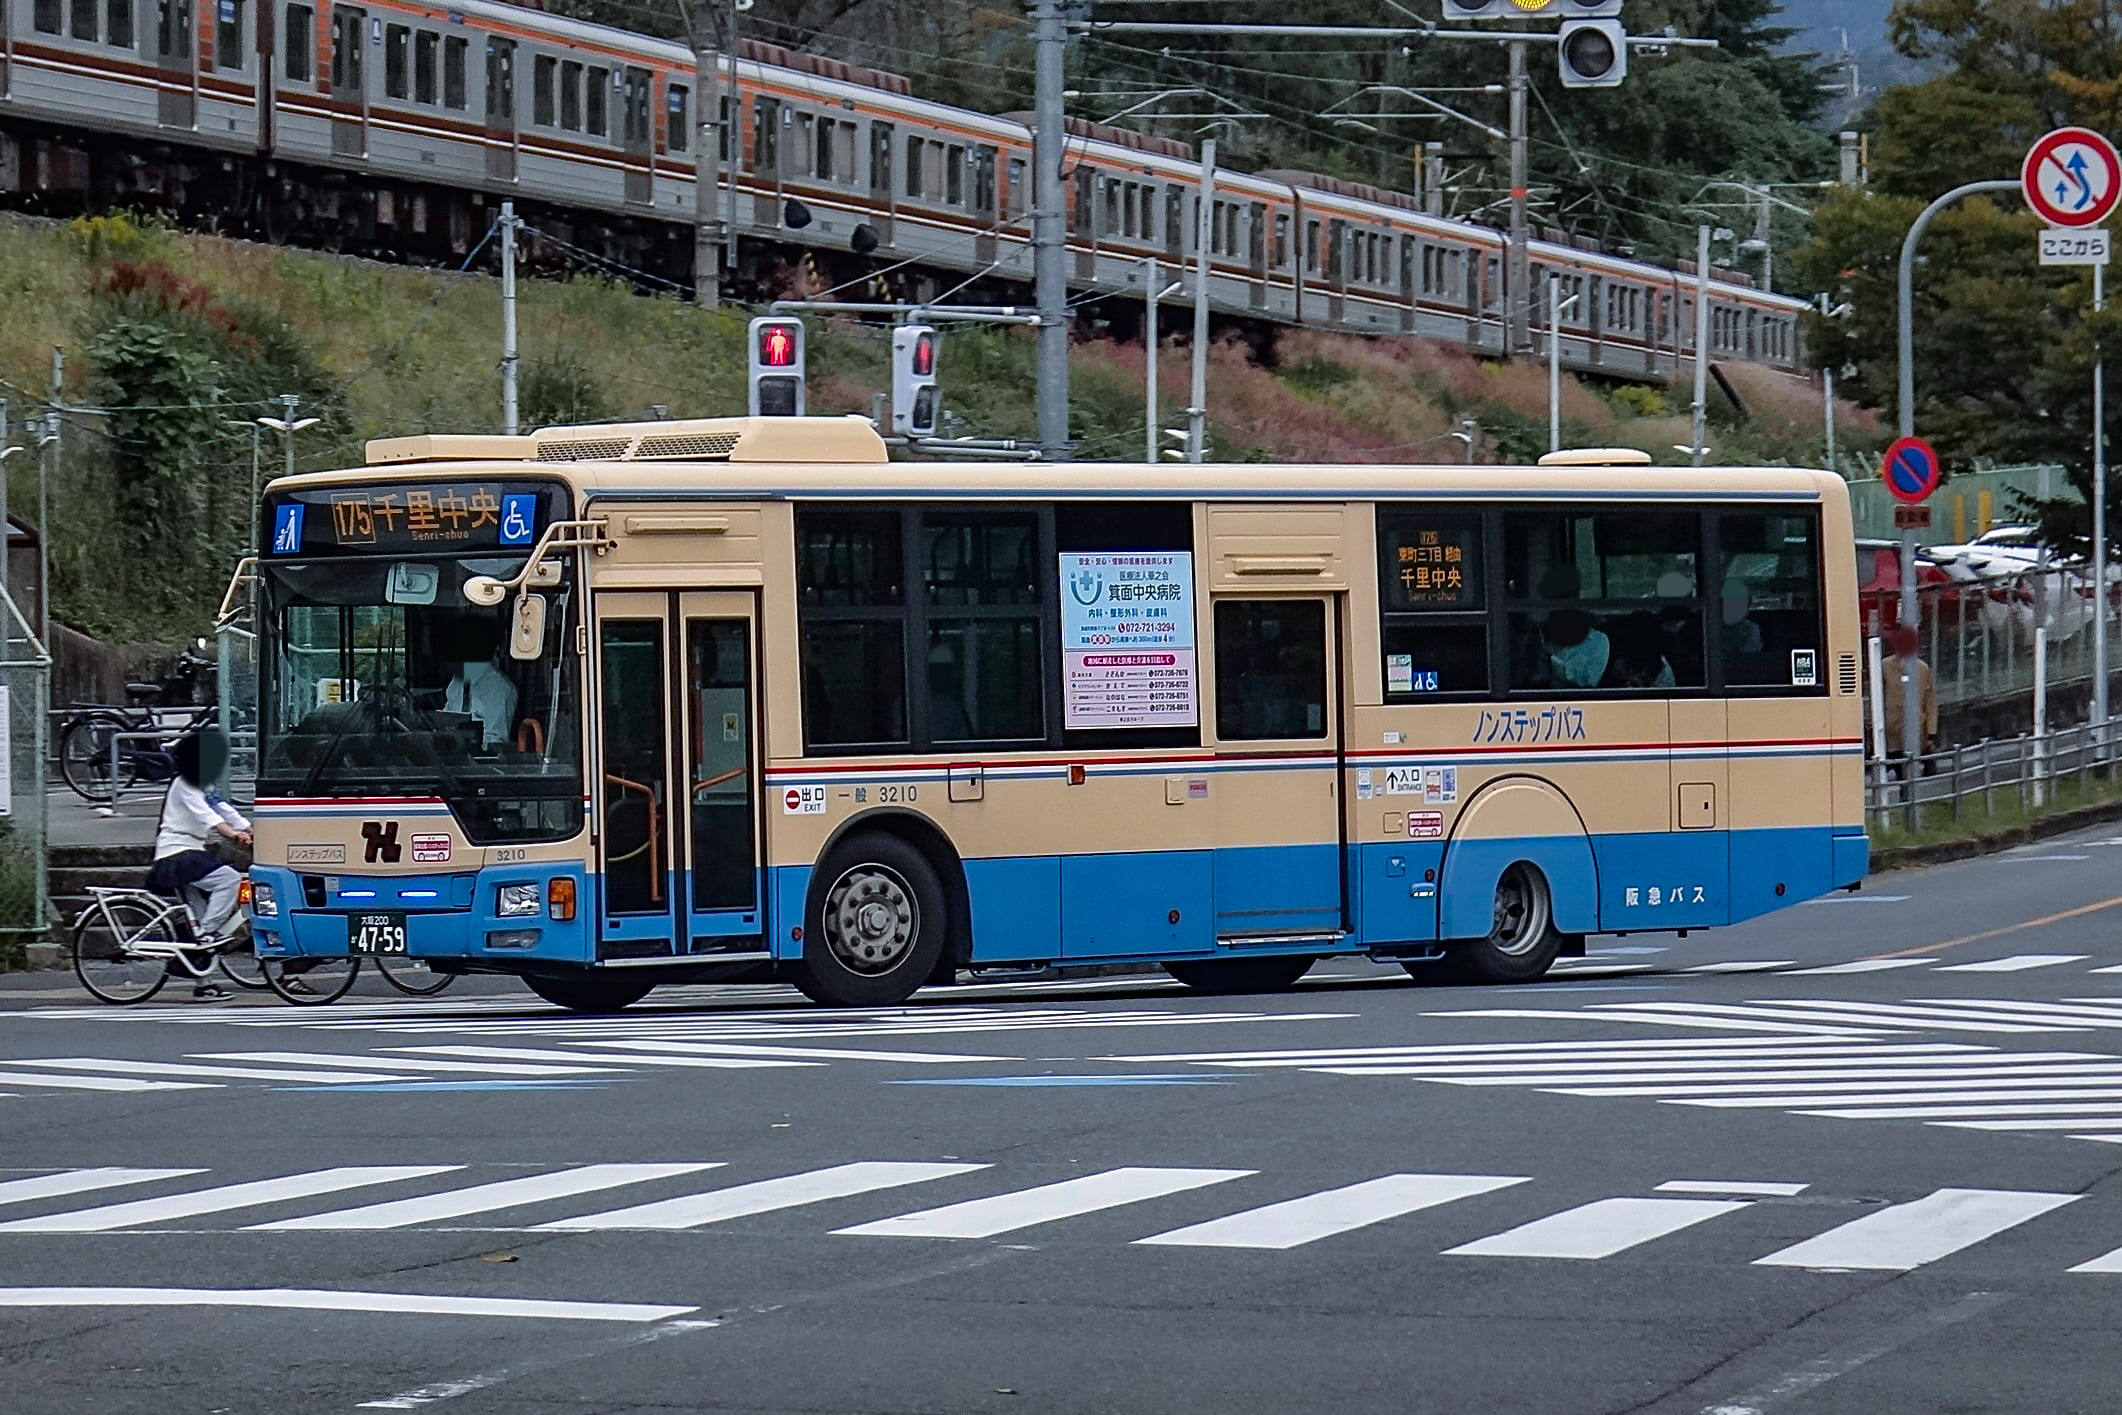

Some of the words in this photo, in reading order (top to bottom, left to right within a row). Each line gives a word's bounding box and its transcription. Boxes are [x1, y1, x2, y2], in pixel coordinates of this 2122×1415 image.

[2043, 239, 2105, 256] ここから
[335, 500, 371, 536] 175
[373, 488, 500, 531] 千里中央
[1400, 565, 1462, 589] 千里中央
[1108, 583, 1181, 601] 箕面中央病院
[1473, 706, 1586, 743] ノンステップバス
[1400, 769, 1420, 782] 入口
[801, 787, 824, 801] 出口
[879, 785, 917, 803] 3210
[804, 803, 821, 812] EXIT
[496, 849, 526, 861] 3210
[1626, 886, 1705, 907] 阪急バス
